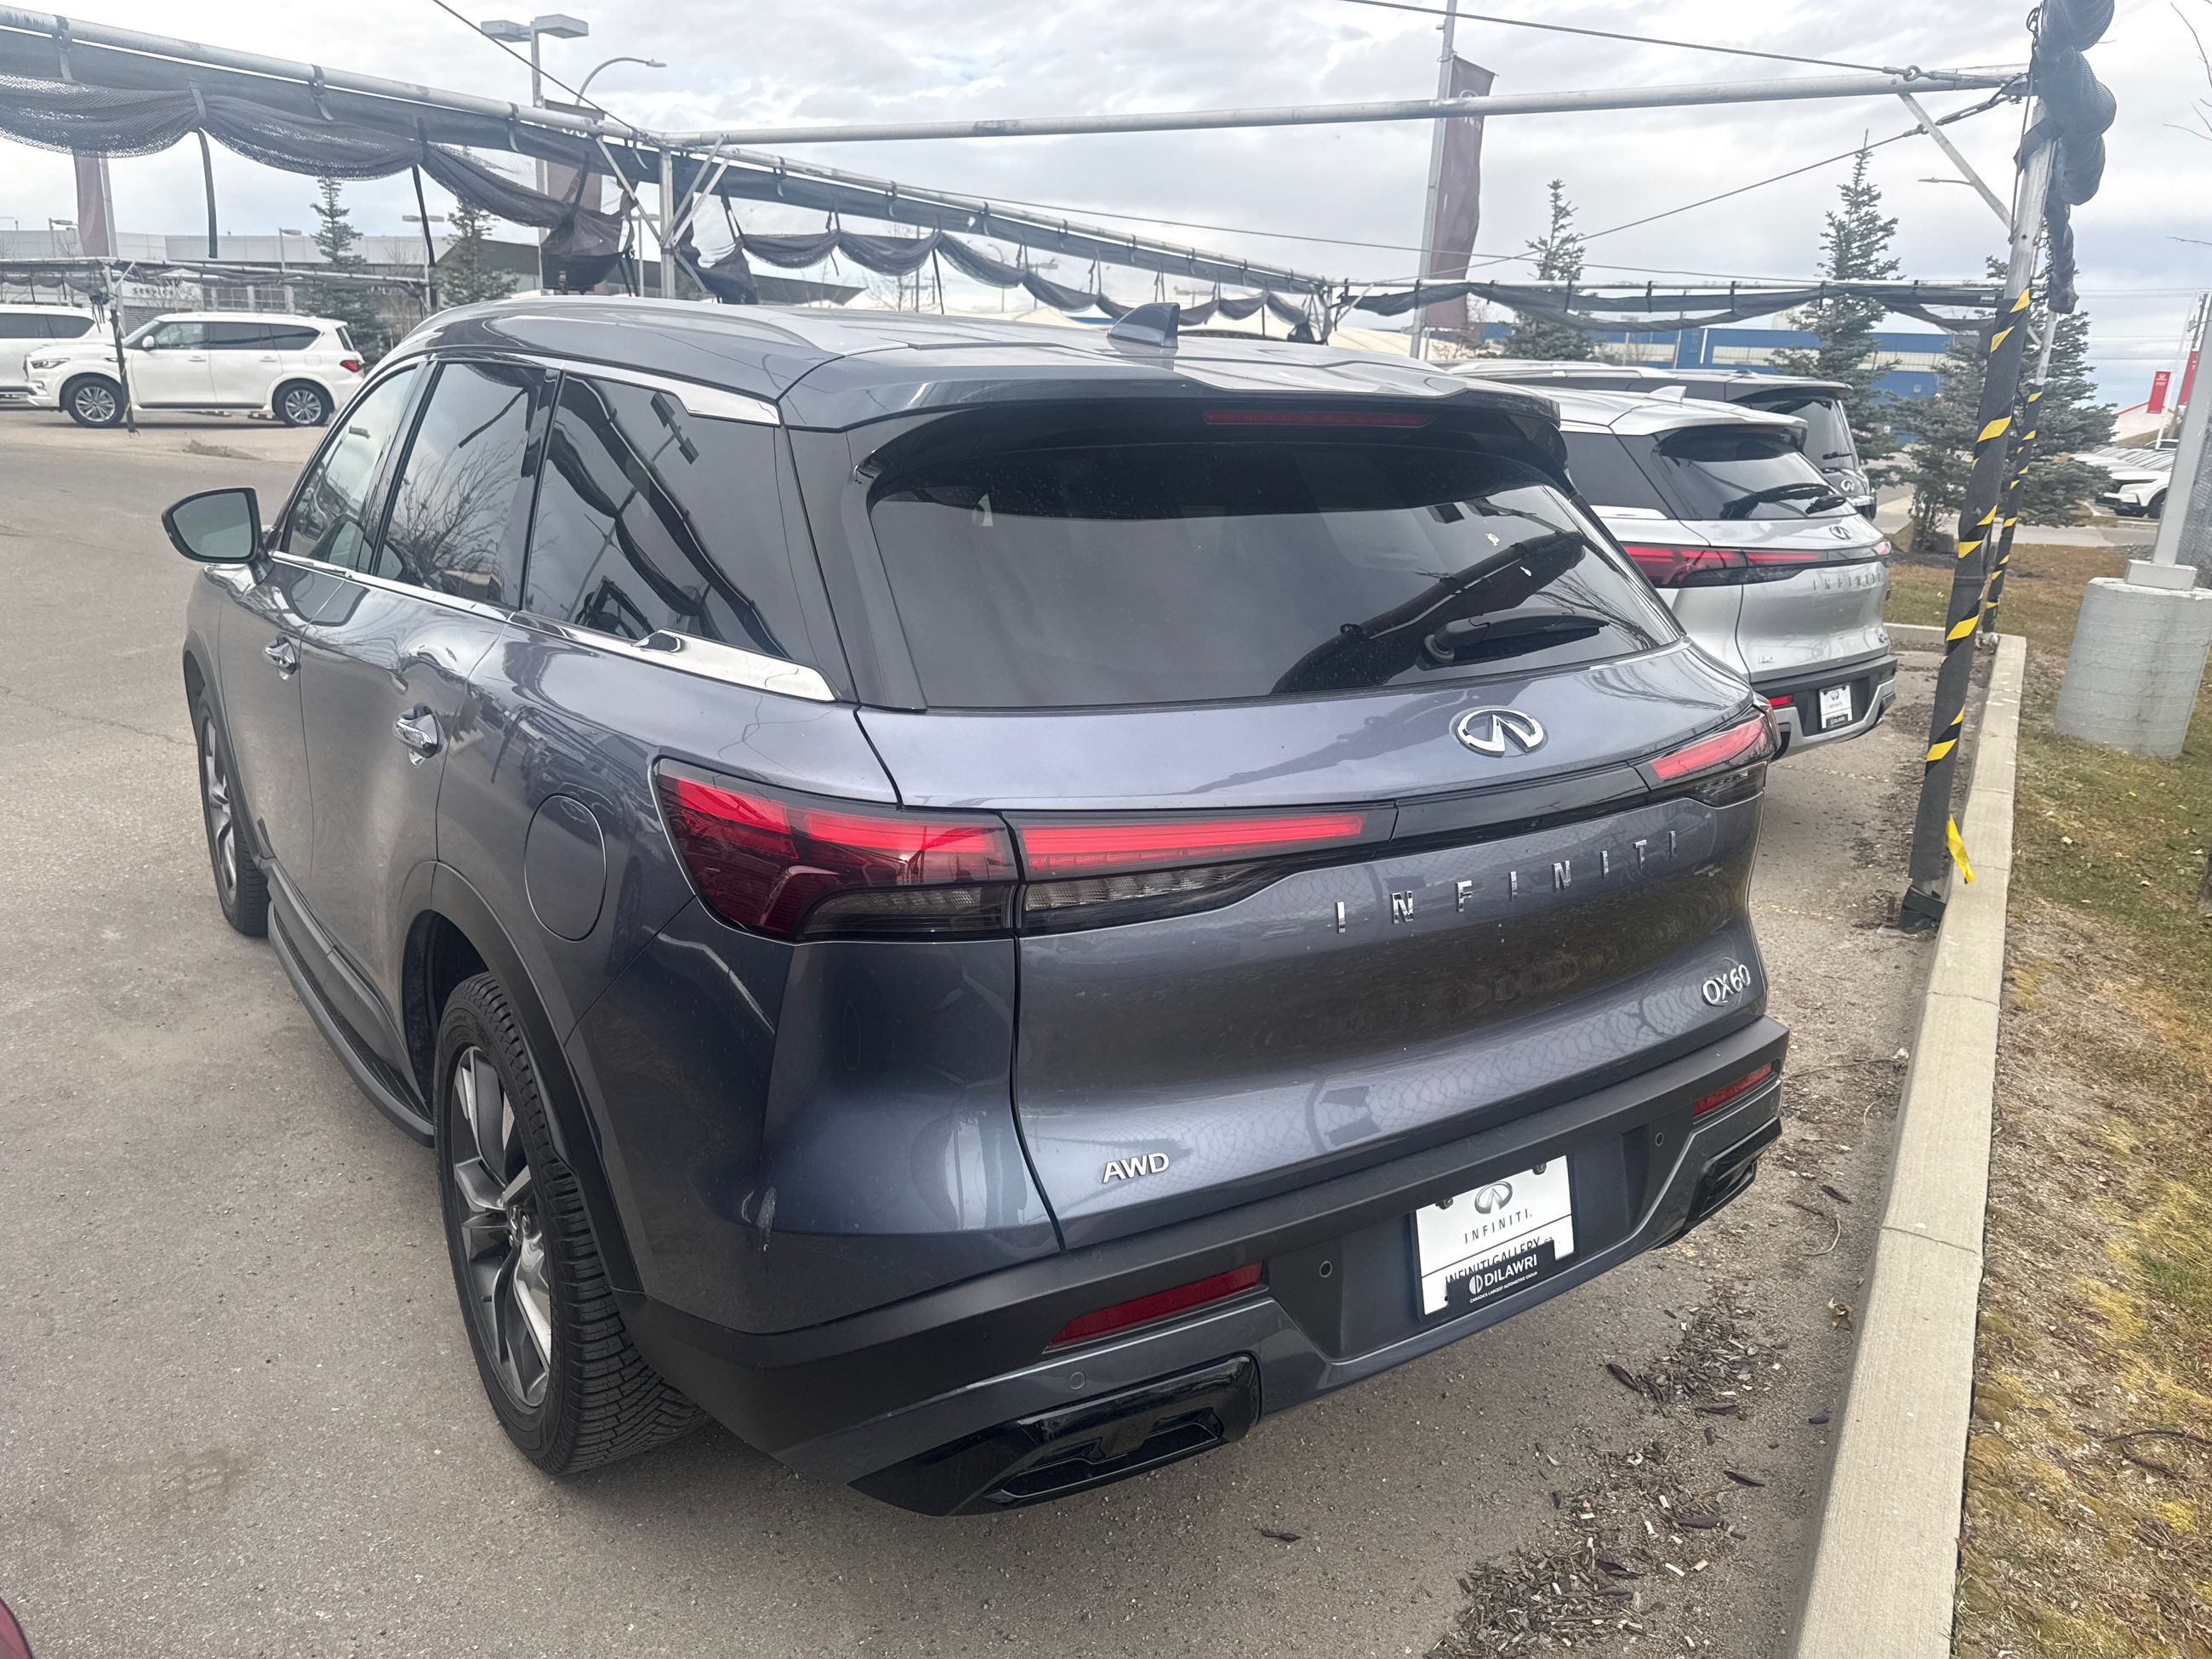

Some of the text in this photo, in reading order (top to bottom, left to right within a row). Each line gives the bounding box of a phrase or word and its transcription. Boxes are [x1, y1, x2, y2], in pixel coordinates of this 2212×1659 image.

[1336, 830, 1677, 933] INFINITI
[1702, 964, 1751, 1005] QX60
[1102, 1152, 1170, 1183] AWD
[1463, 1208, 1530, 1244] INFINITI
[1484, 1253, 1538, 1287] DILAWRI
